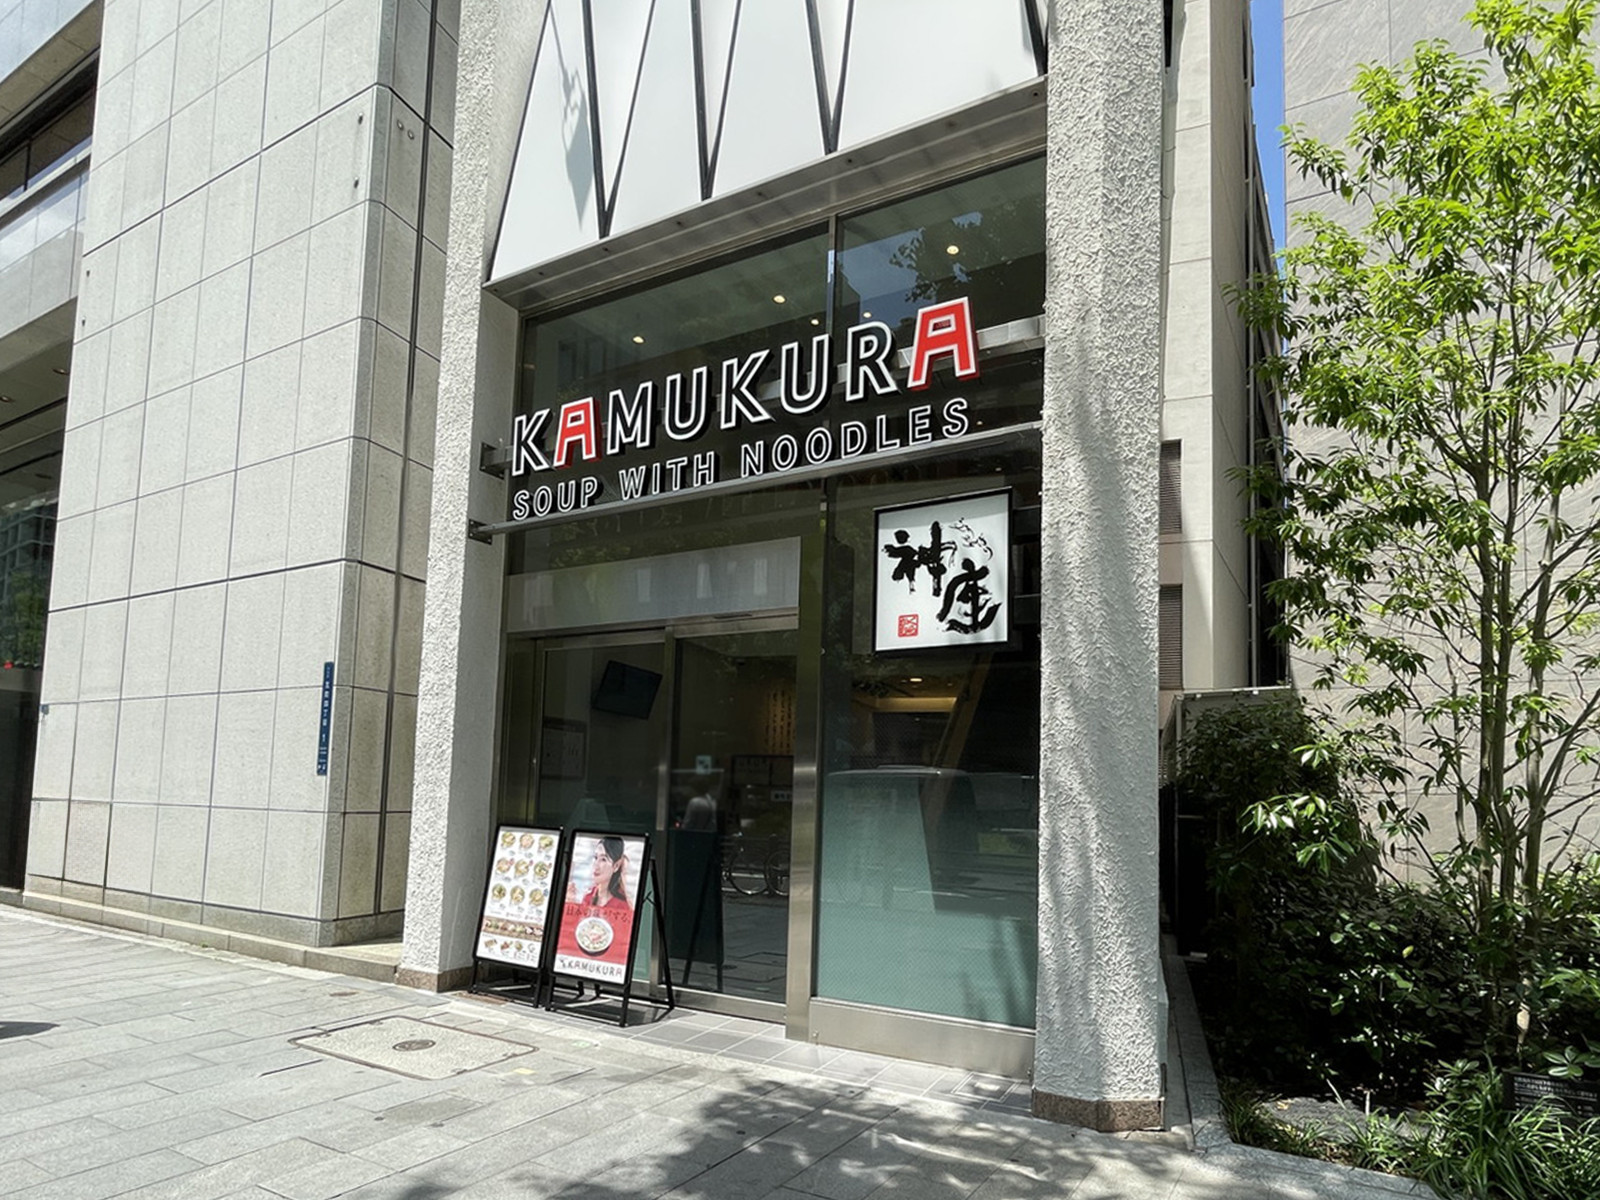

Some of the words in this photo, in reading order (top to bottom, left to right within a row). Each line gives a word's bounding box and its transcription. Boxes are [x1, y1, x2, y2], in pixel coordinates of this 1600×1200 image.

[511, 296, 977, 476] KAMUKURA
[512, 476, 598, 520] SOUP
[618, 450, 715, 500] WITH
[741, 397, 969, 478] NOODLES
[881, 520, 1002, 634] 神座
[567, 958, 623, 977] KAMUKURA
